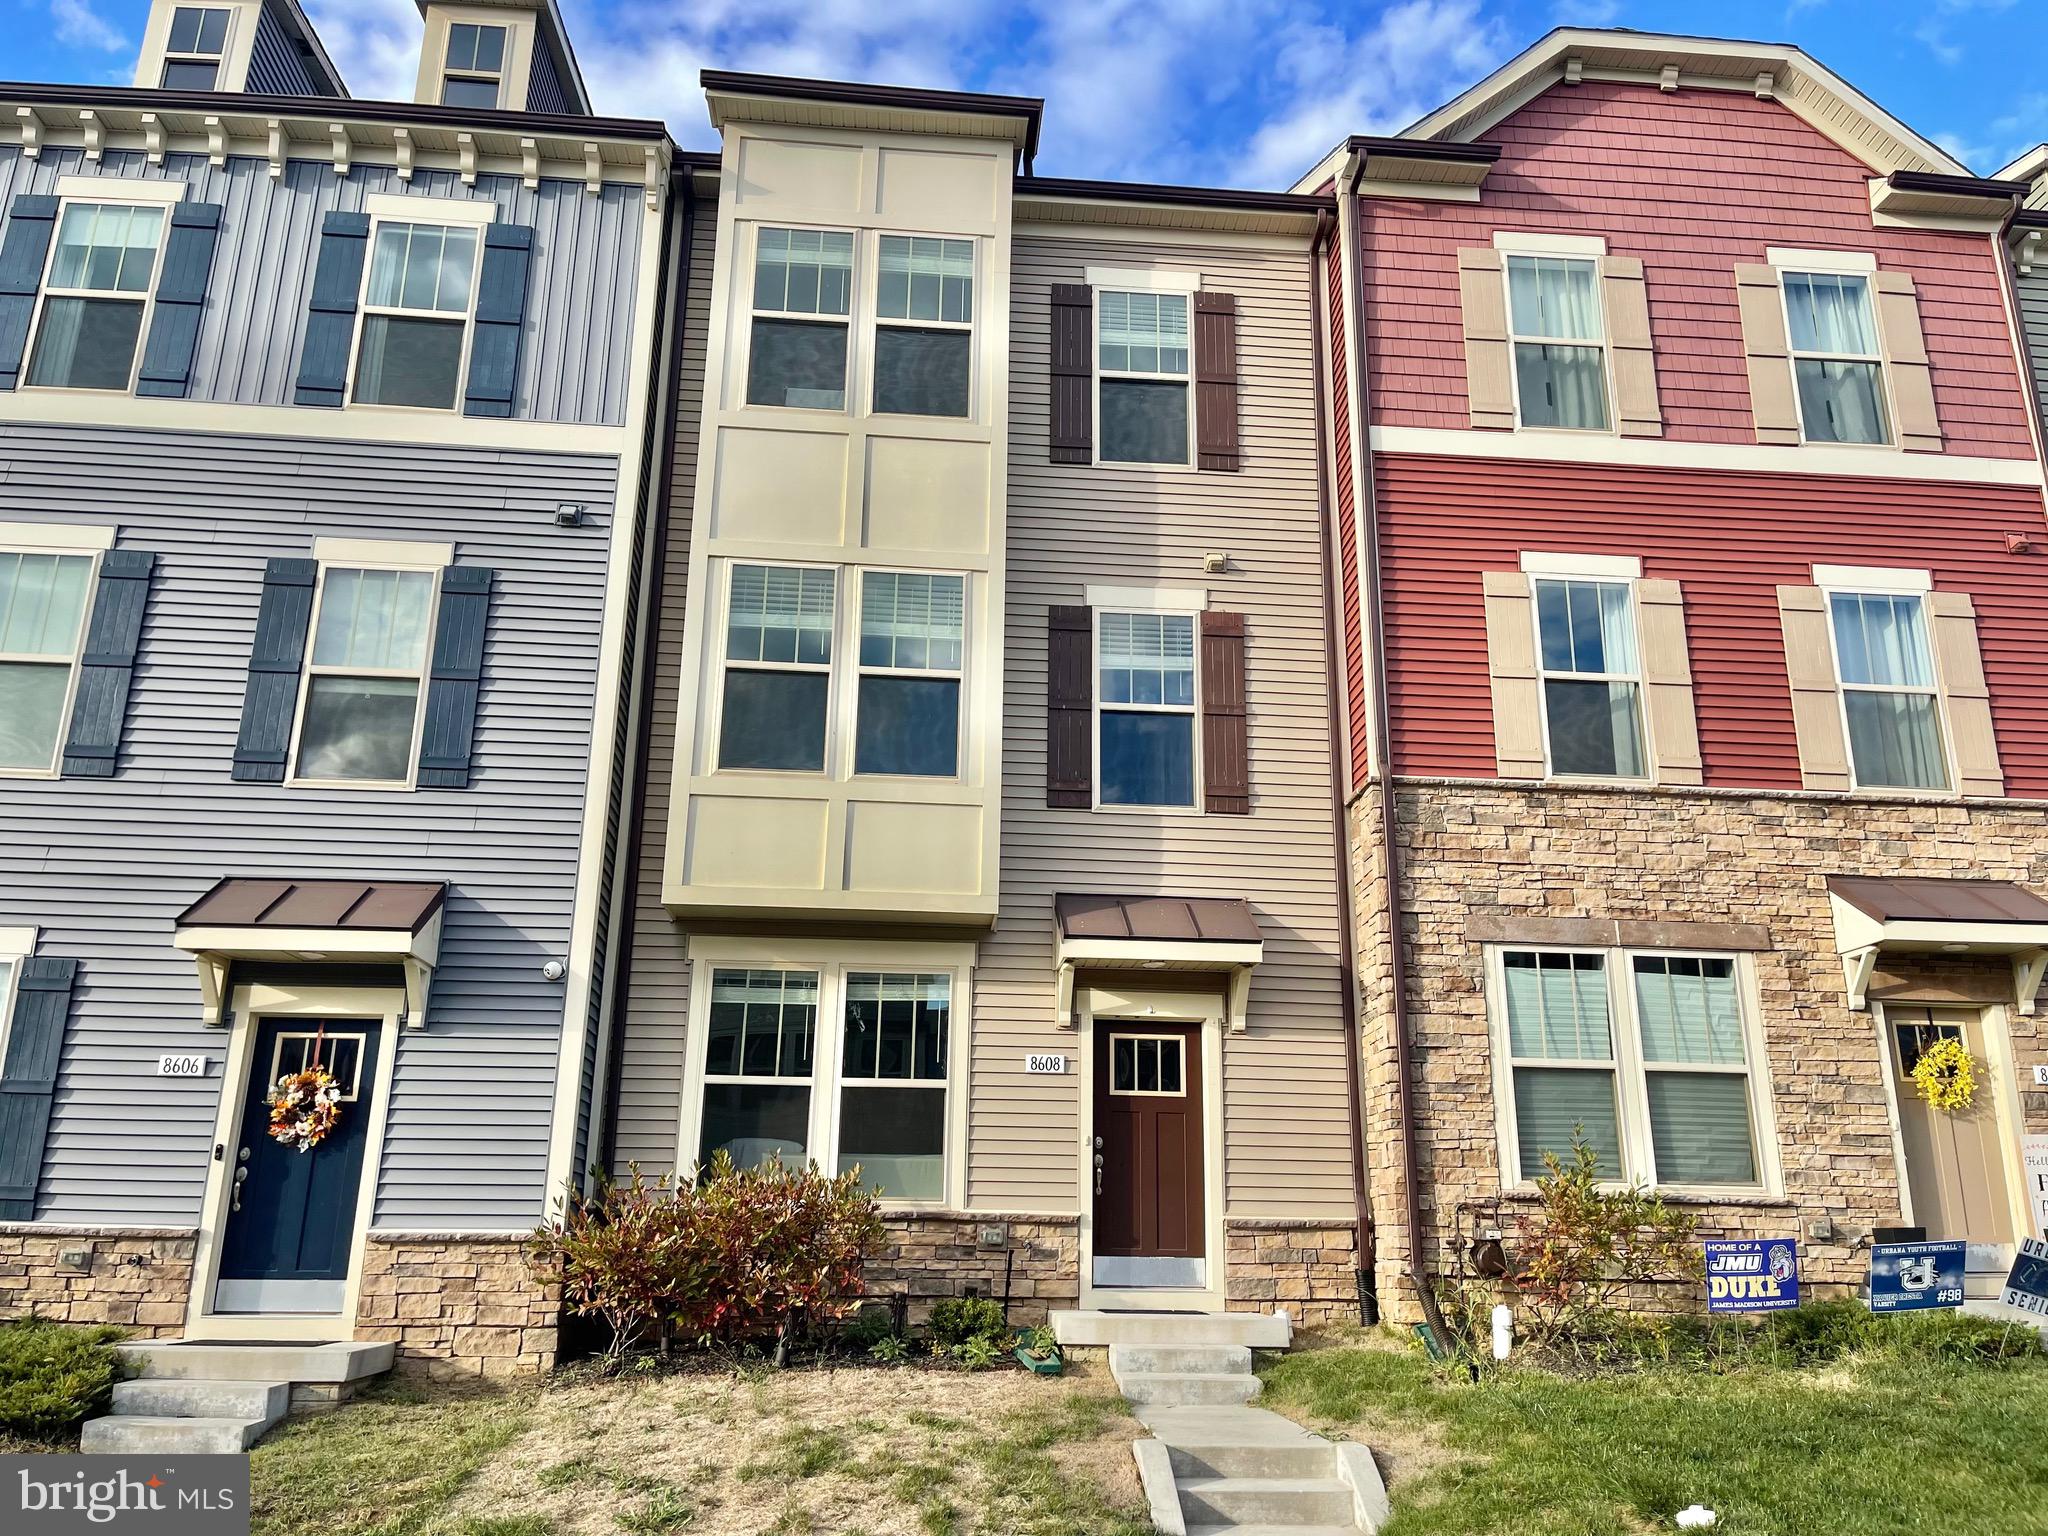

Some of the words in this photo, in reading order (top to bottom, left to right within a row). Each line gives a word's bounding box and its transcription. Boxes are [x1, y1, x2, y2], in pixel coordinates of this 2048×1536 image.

[163, 1057, 199, 1074] 8606
[1030, 1056, 1060, 1071] 8608
[1707, 1243, 1737, 1252] HOME
[1738, 1243, 1752, 1251] OF
[1754, 1243, 1761, 1251] A
[1928, 1244, 1957, 1252] FOOTBALL
[1710, 1255, 1761, 1271] JMU
[1709, 1275, 1781, 1298] DUKE
[1937, 1289, 1962, 1302] #98
